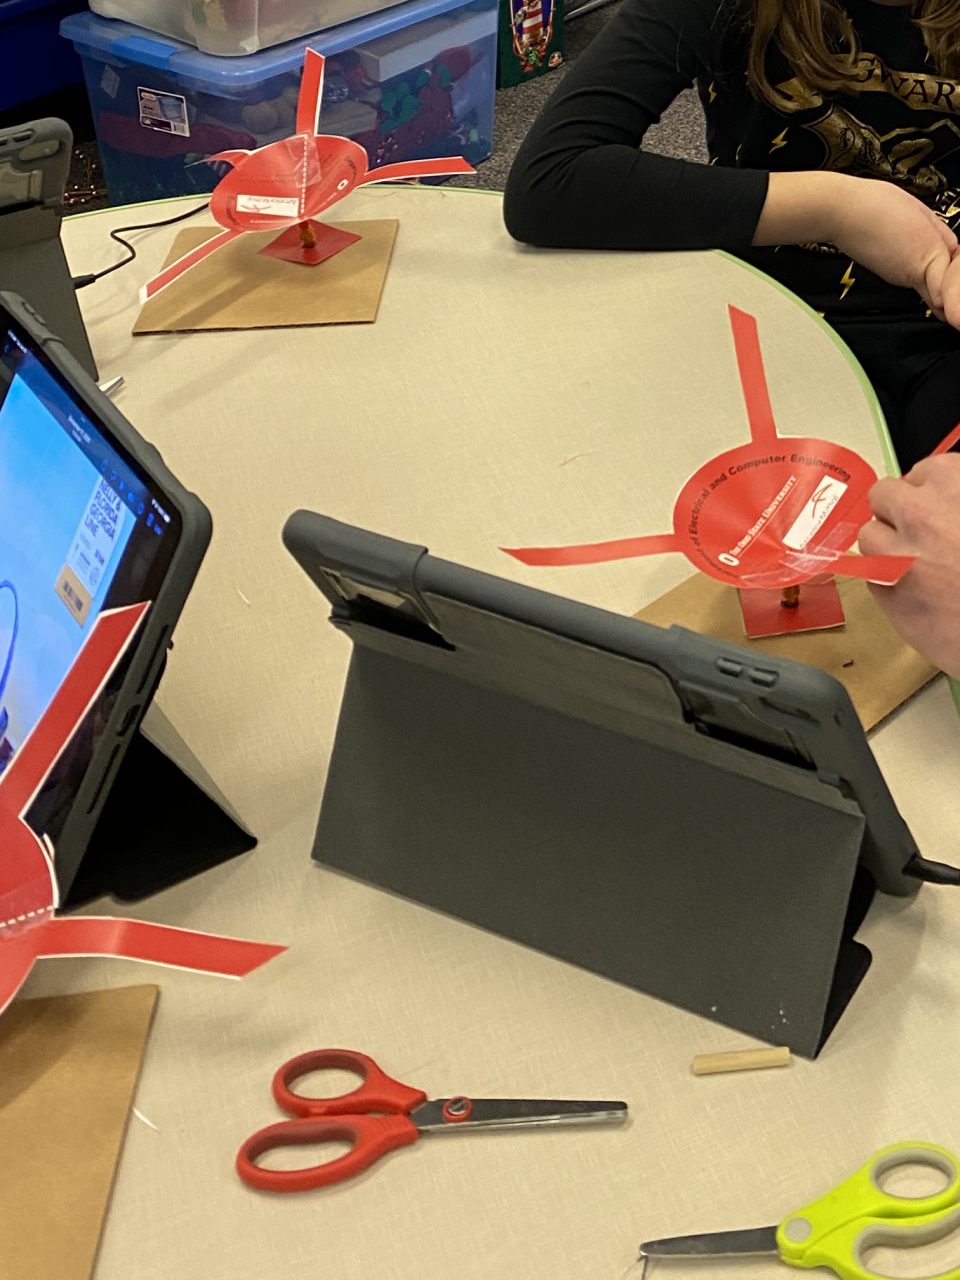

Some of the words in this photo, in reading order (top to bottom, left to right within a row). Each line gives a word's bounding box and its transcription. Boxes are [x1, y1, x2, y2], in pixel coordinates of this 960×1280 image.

[93, 490, 119, 524] FLORIDA
[688, 488, 710, 535] Electrical
[710, 472, 727, 491] and
[728, 455, 786, 476] Computer
[790, 454, 852, 483] Engineering
[84, 514, 99, 539] LINE
[88, 503, 114, 544] GEORGIA
